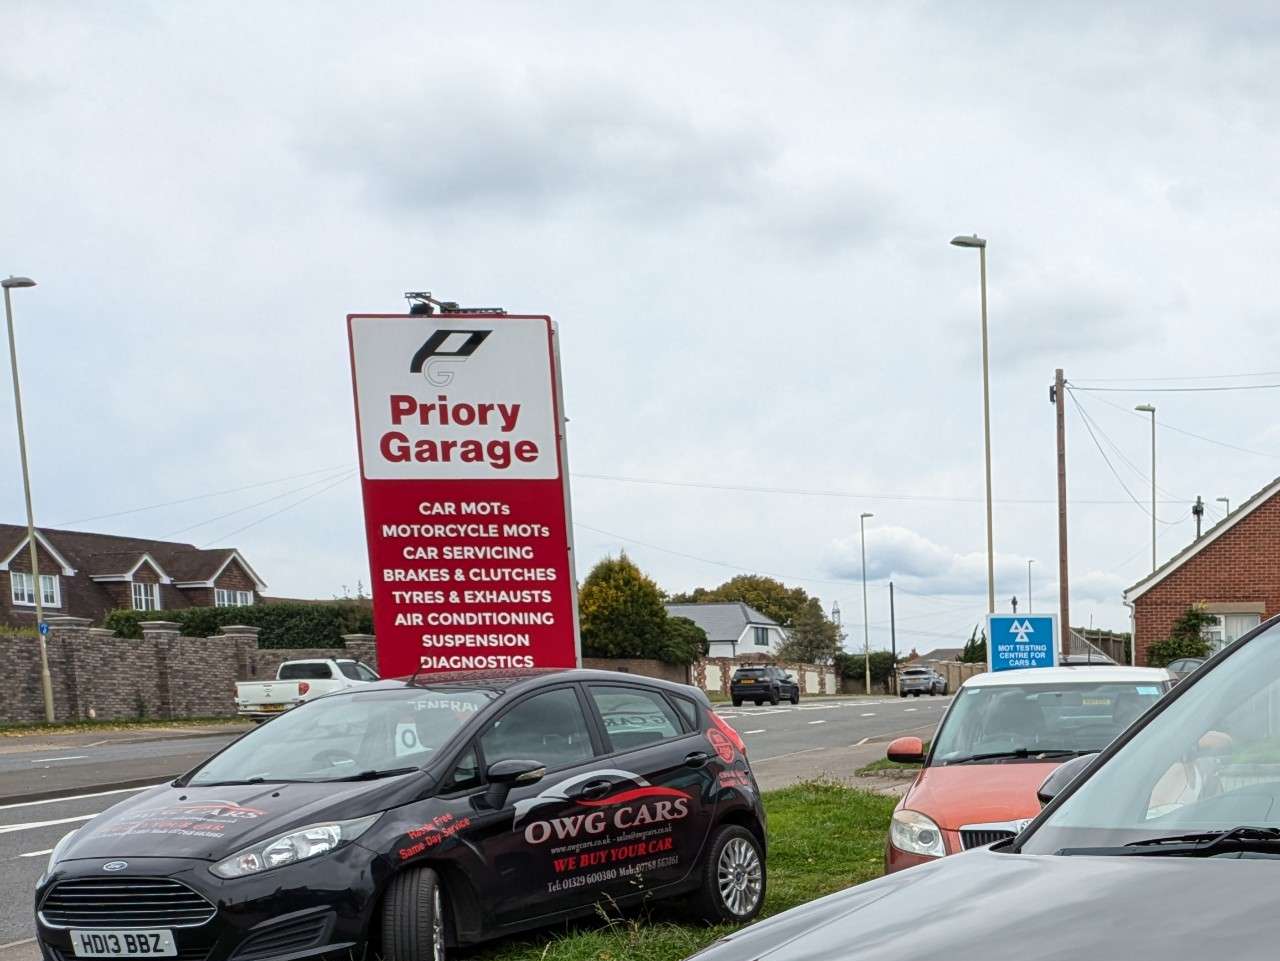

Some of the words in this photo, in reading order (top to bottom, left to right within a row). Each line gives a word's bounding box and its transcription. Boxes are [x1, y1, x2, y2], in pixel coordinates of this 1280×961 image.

[389, 394, 521, 432] Priory
[379, 431, 539, 469] Garage
[419, 502, 456, 515] CAR
[461, 502, 510, 515] MOTs
[382, 524, 498, 537] MOTORCYCLE
[503, 524, 550, 537] MOTs
[403, 547, 439, 559] CAR
[443, 546, 534, 559] SERVICING
[383, 569, 449, 581] BRAKES
[454, 569, 465, 581] &
[469, 568, 556, 581] CLUTCHES
[392, 591, 445, 604] TYRES
[449, 591, 460, 604] &
[464, 590, 552, 603] EXHAUSTS
[395, 613, 424, 626] AIR
[427, 612, 554, 626] CONDITIONING
[422, 634, 530, 647] SUSPENSION
[998, 644, 1014, 652] MOT
[1016, 644, 1047, 652] TESTING
[420, 655, 534, 669] DIAGNOSTICS
[524, 811, 607, 844] OWG
[613, 798, 689, 829] CARS
[400, 842, 425, 860] Same
[425, 833, 441, 847] Day
[442, 816, 471, 837] Service
[553, 857, 576, 873] WE
[579, 849, 609, 869] BUY
[609, 843, 647, 862] YOUR
[648, 837, 673, 853] CAR
[547, 880, 562, 893] Tel:
[562, 874, 586, 890] 01329
[586, 868, 617, 884] 600380
[80, 933, 122, 954] HD13
[124, 933, 165, 954] BBZ
